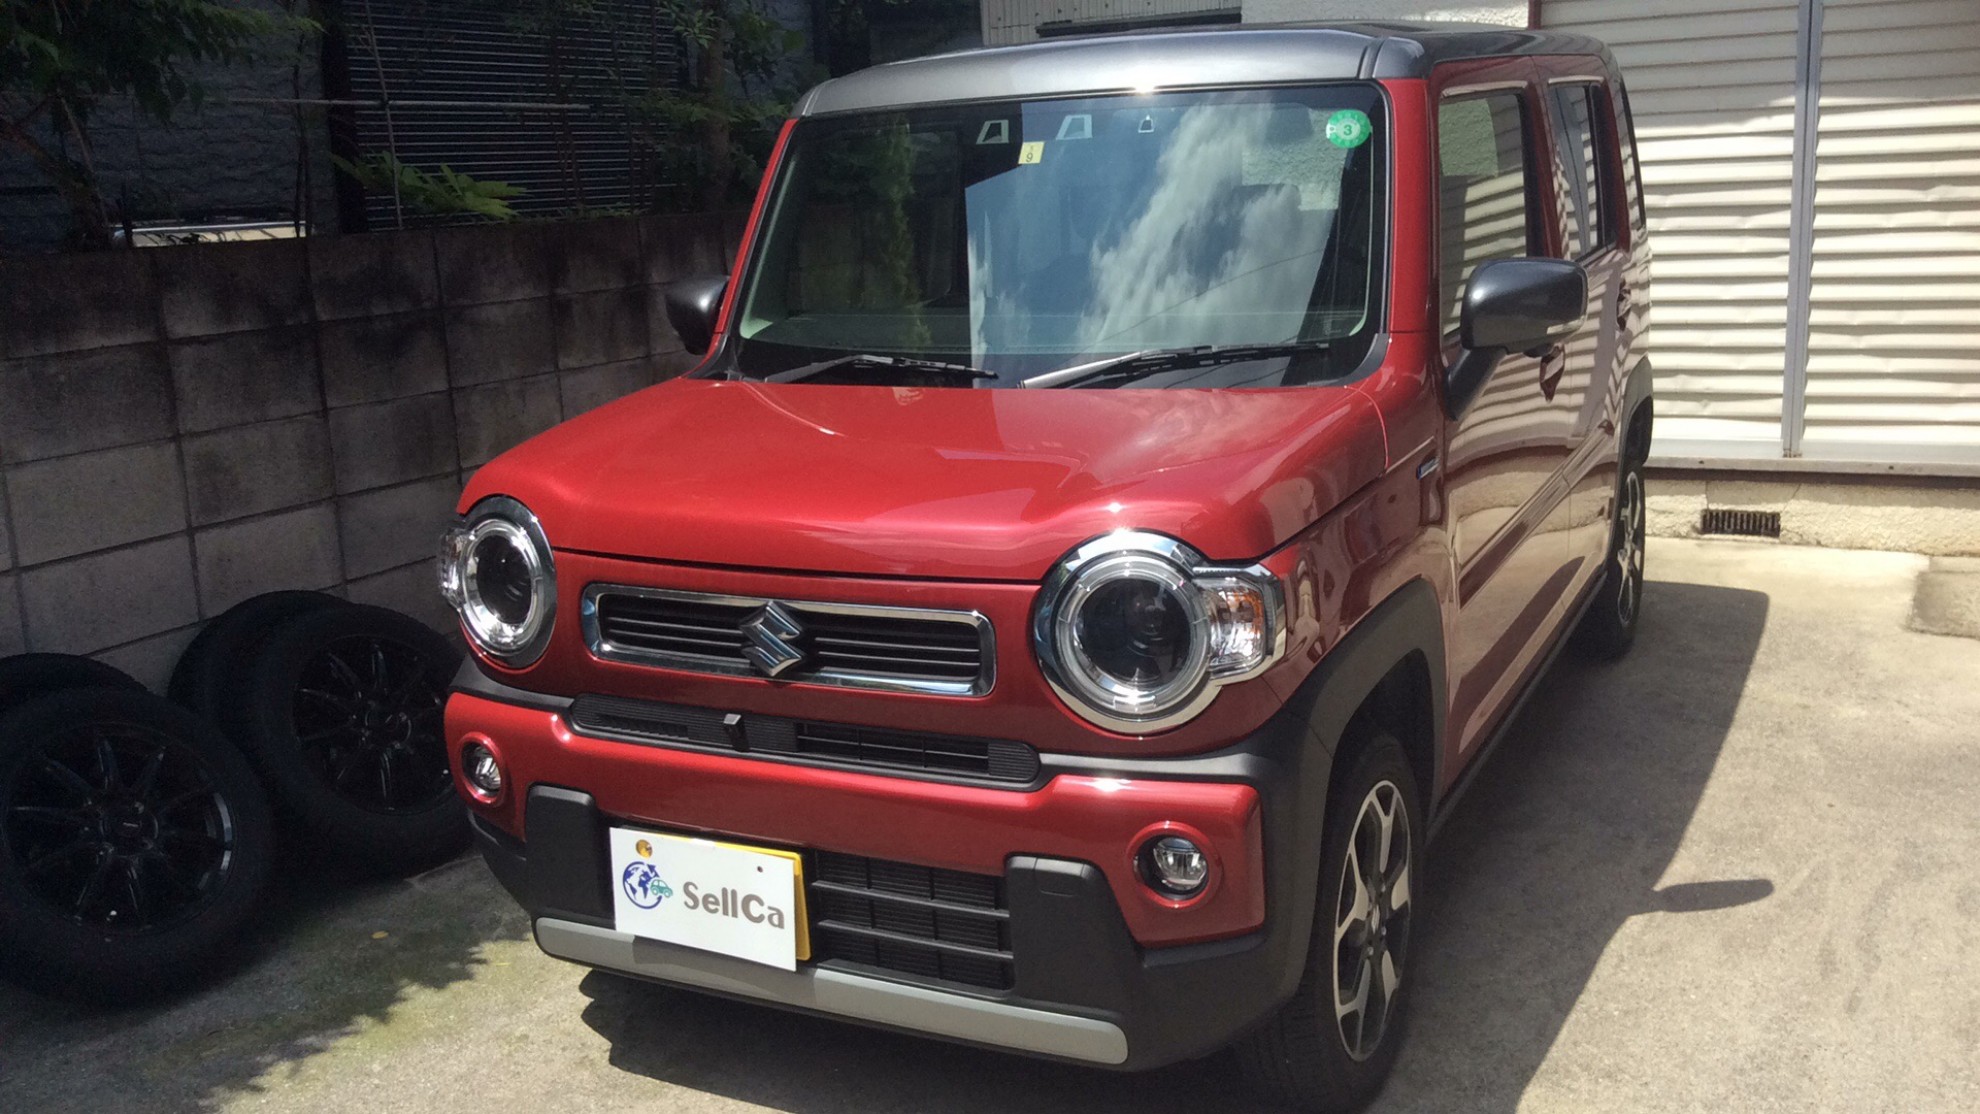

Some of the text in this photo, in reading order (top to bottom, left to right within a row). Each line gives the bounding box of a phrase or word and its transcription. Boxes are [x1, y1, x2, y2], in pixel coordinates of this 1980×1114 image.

[1343, 124, 1353, 136] 3
[1025, 152, 1034, 163] 9
[683, 881, 785, 929] SellCa
